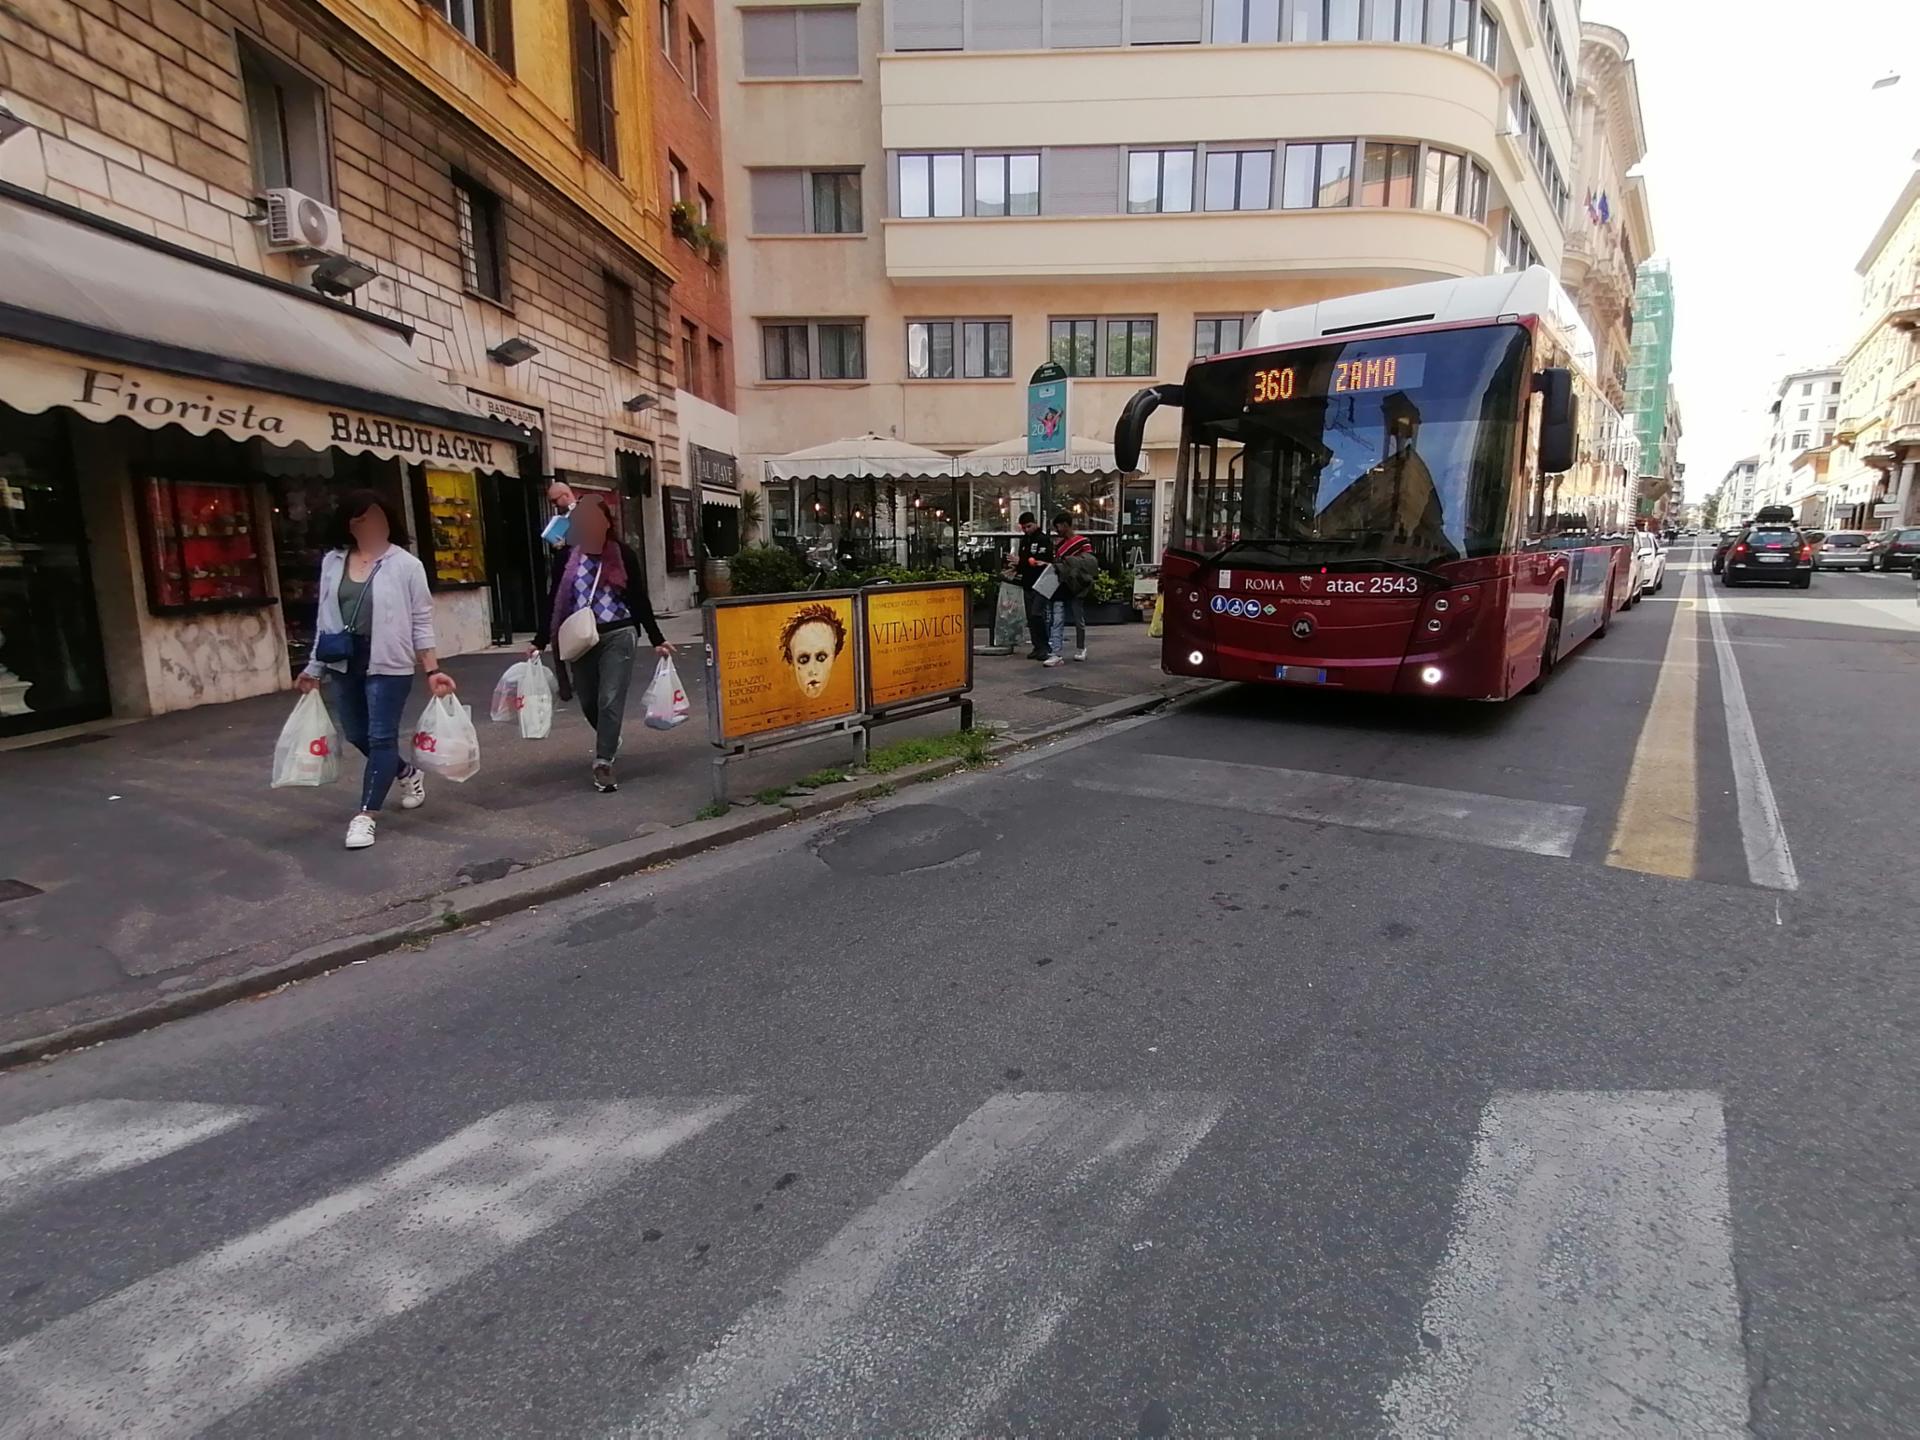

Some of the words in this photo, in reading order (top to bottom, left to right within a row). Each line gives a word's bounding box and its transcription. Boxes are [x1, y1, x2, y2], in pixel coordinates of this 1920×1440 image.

[1254, 367, 1295, 403] 360
[1336, 356, 1397, 392] ZAMA
[72, 366, 285, 434] Fiorista
[488, 401, 537, 425] BARDUAGNI
[328, 411, 495, 466] BARDUAGNI
[702, 460, 711, 479] AL
[713, 462, 734, 483] PIAVE
[1245, 578, 1285, 591] ROMA
[1326, 578, 1365, 593] atac
[1369, 576, 1419, 593] 2543
[729, 696, 754, 707] ROMA
